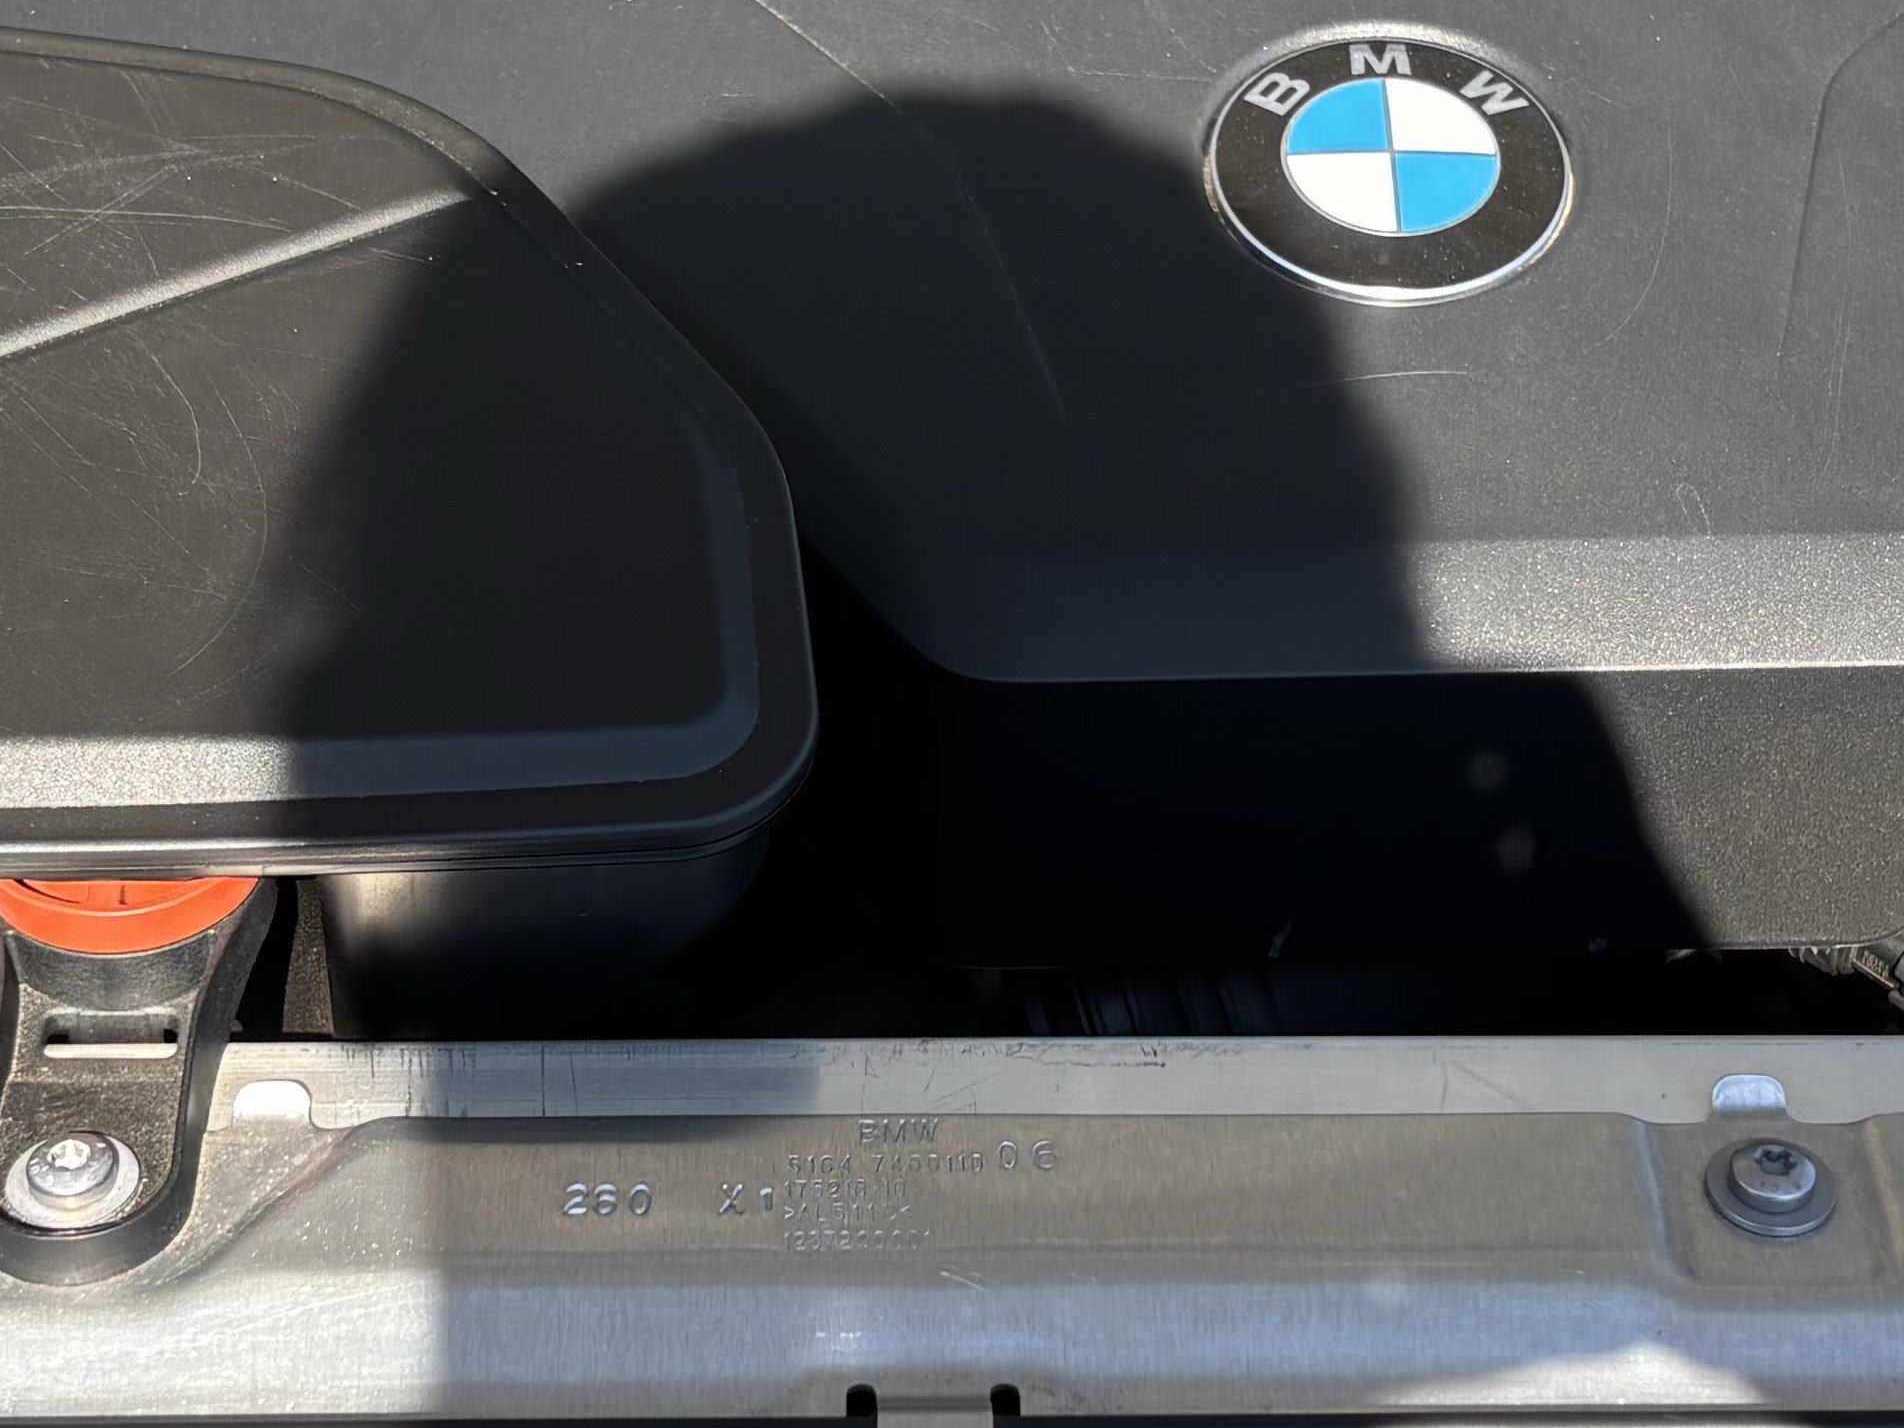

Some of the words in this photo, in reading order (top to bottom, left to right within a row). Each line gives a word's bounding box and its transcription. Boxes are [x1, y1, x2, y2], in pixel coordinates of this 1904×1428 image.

[1243, 42, 1530, 117] BMW
[858, 1118, 939, 1144] BMW
[563, 1181, 653, 1216] 260
